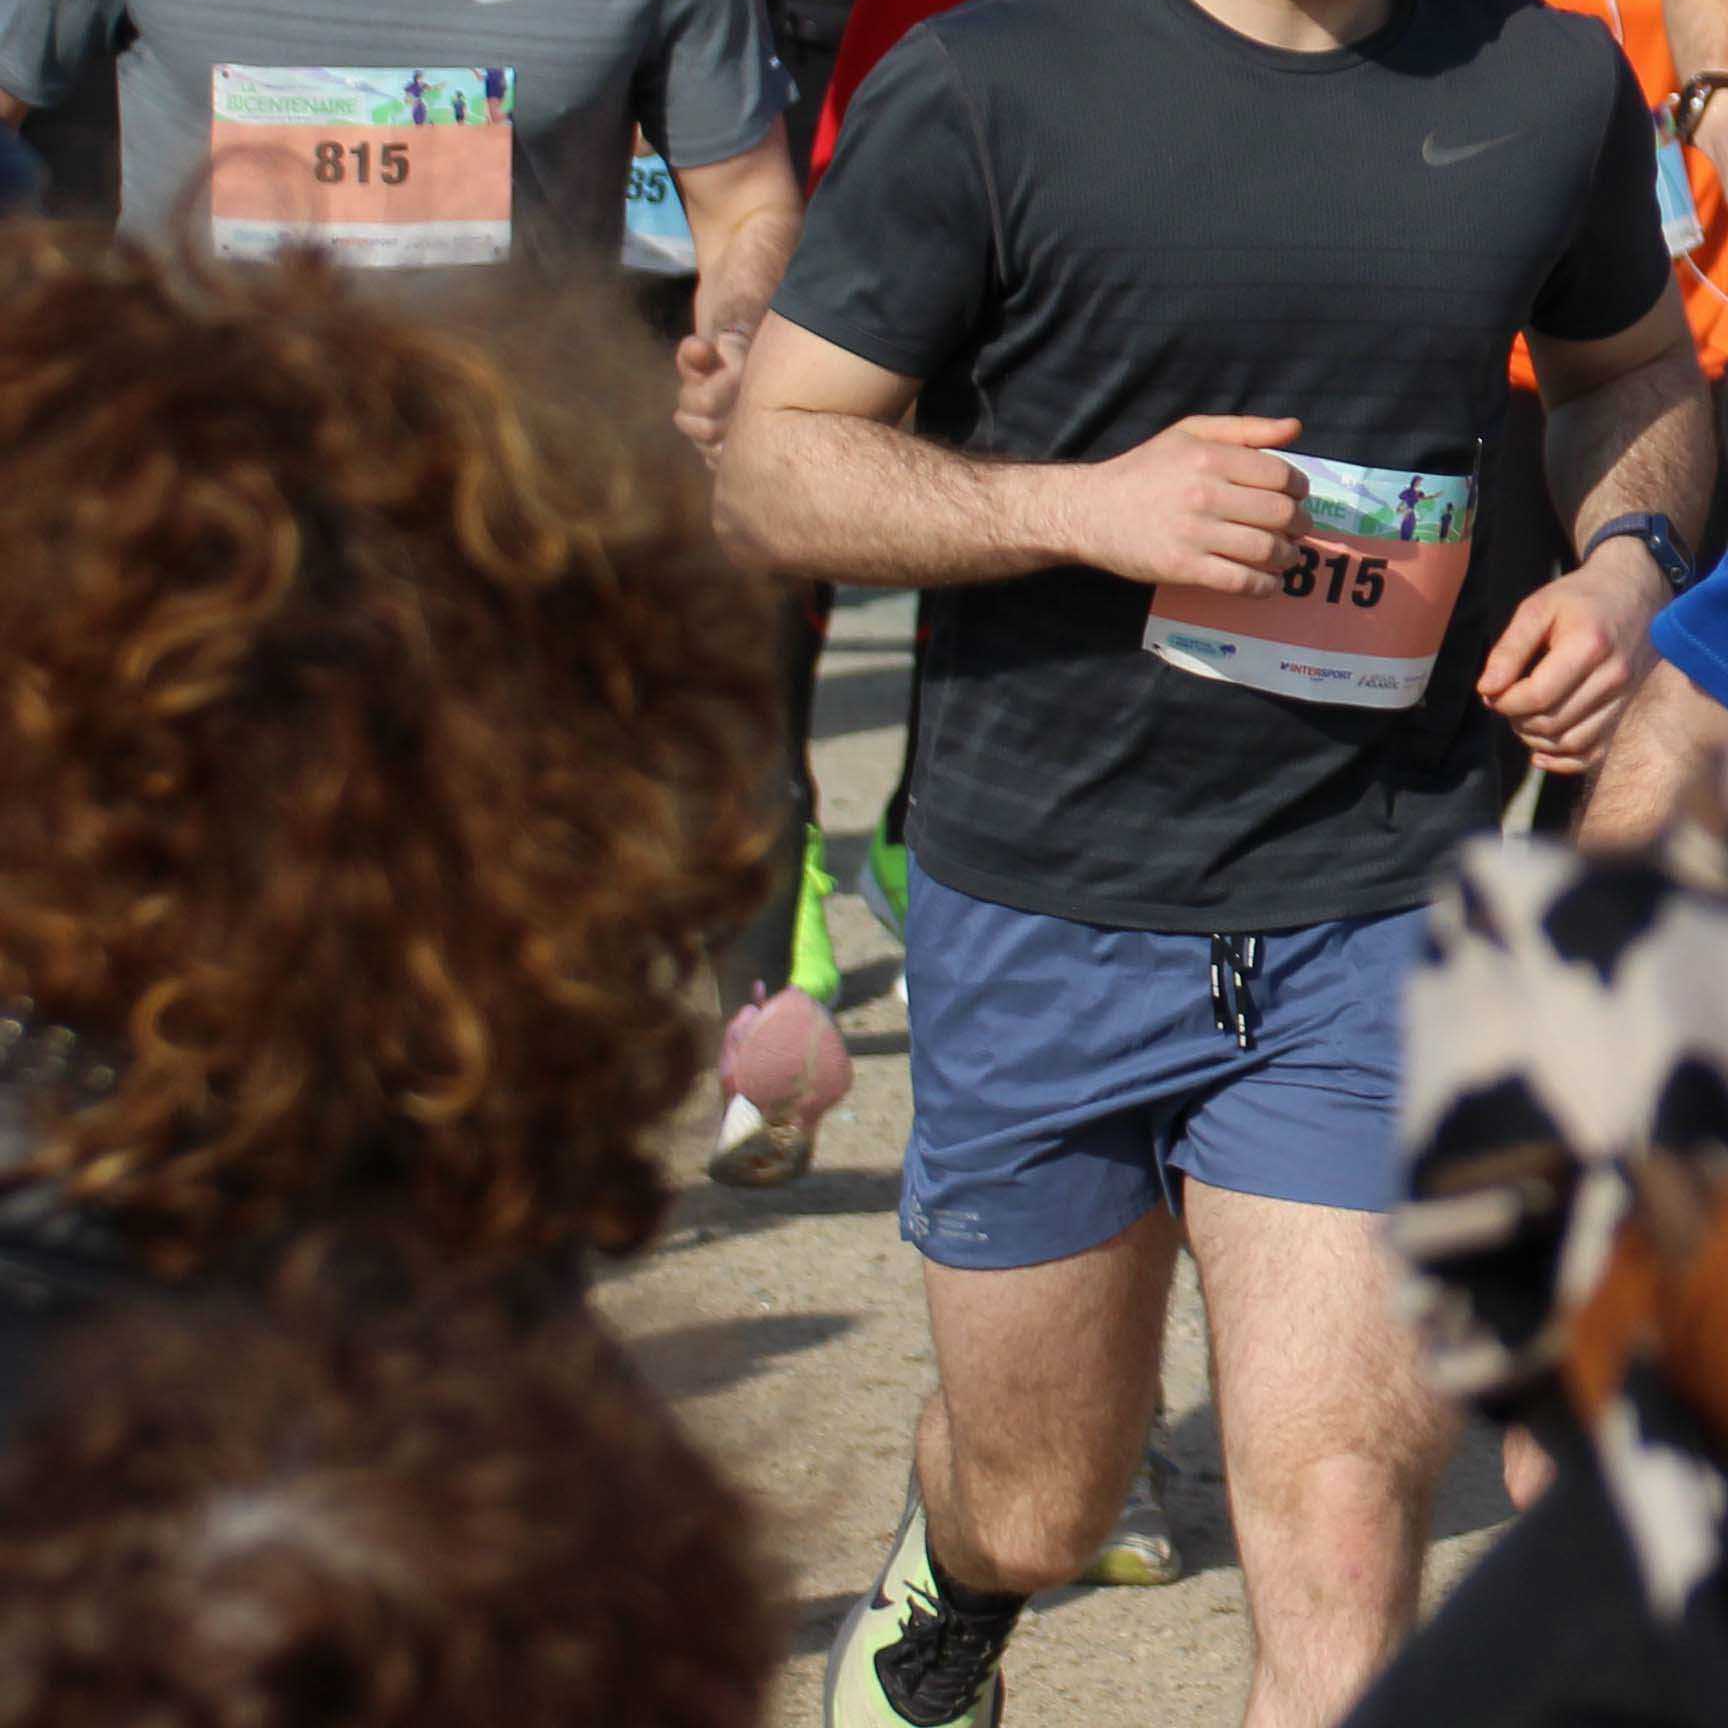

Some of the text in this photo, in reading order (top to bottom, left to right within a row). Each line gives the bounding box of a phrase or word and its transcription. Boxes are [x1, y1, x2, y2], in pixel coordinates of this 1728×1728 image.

[226, 94, 358, 115] BICENTENAIRE
[314, 140, 411, 186] 815
[1283, 543, 1389, 608] 815
